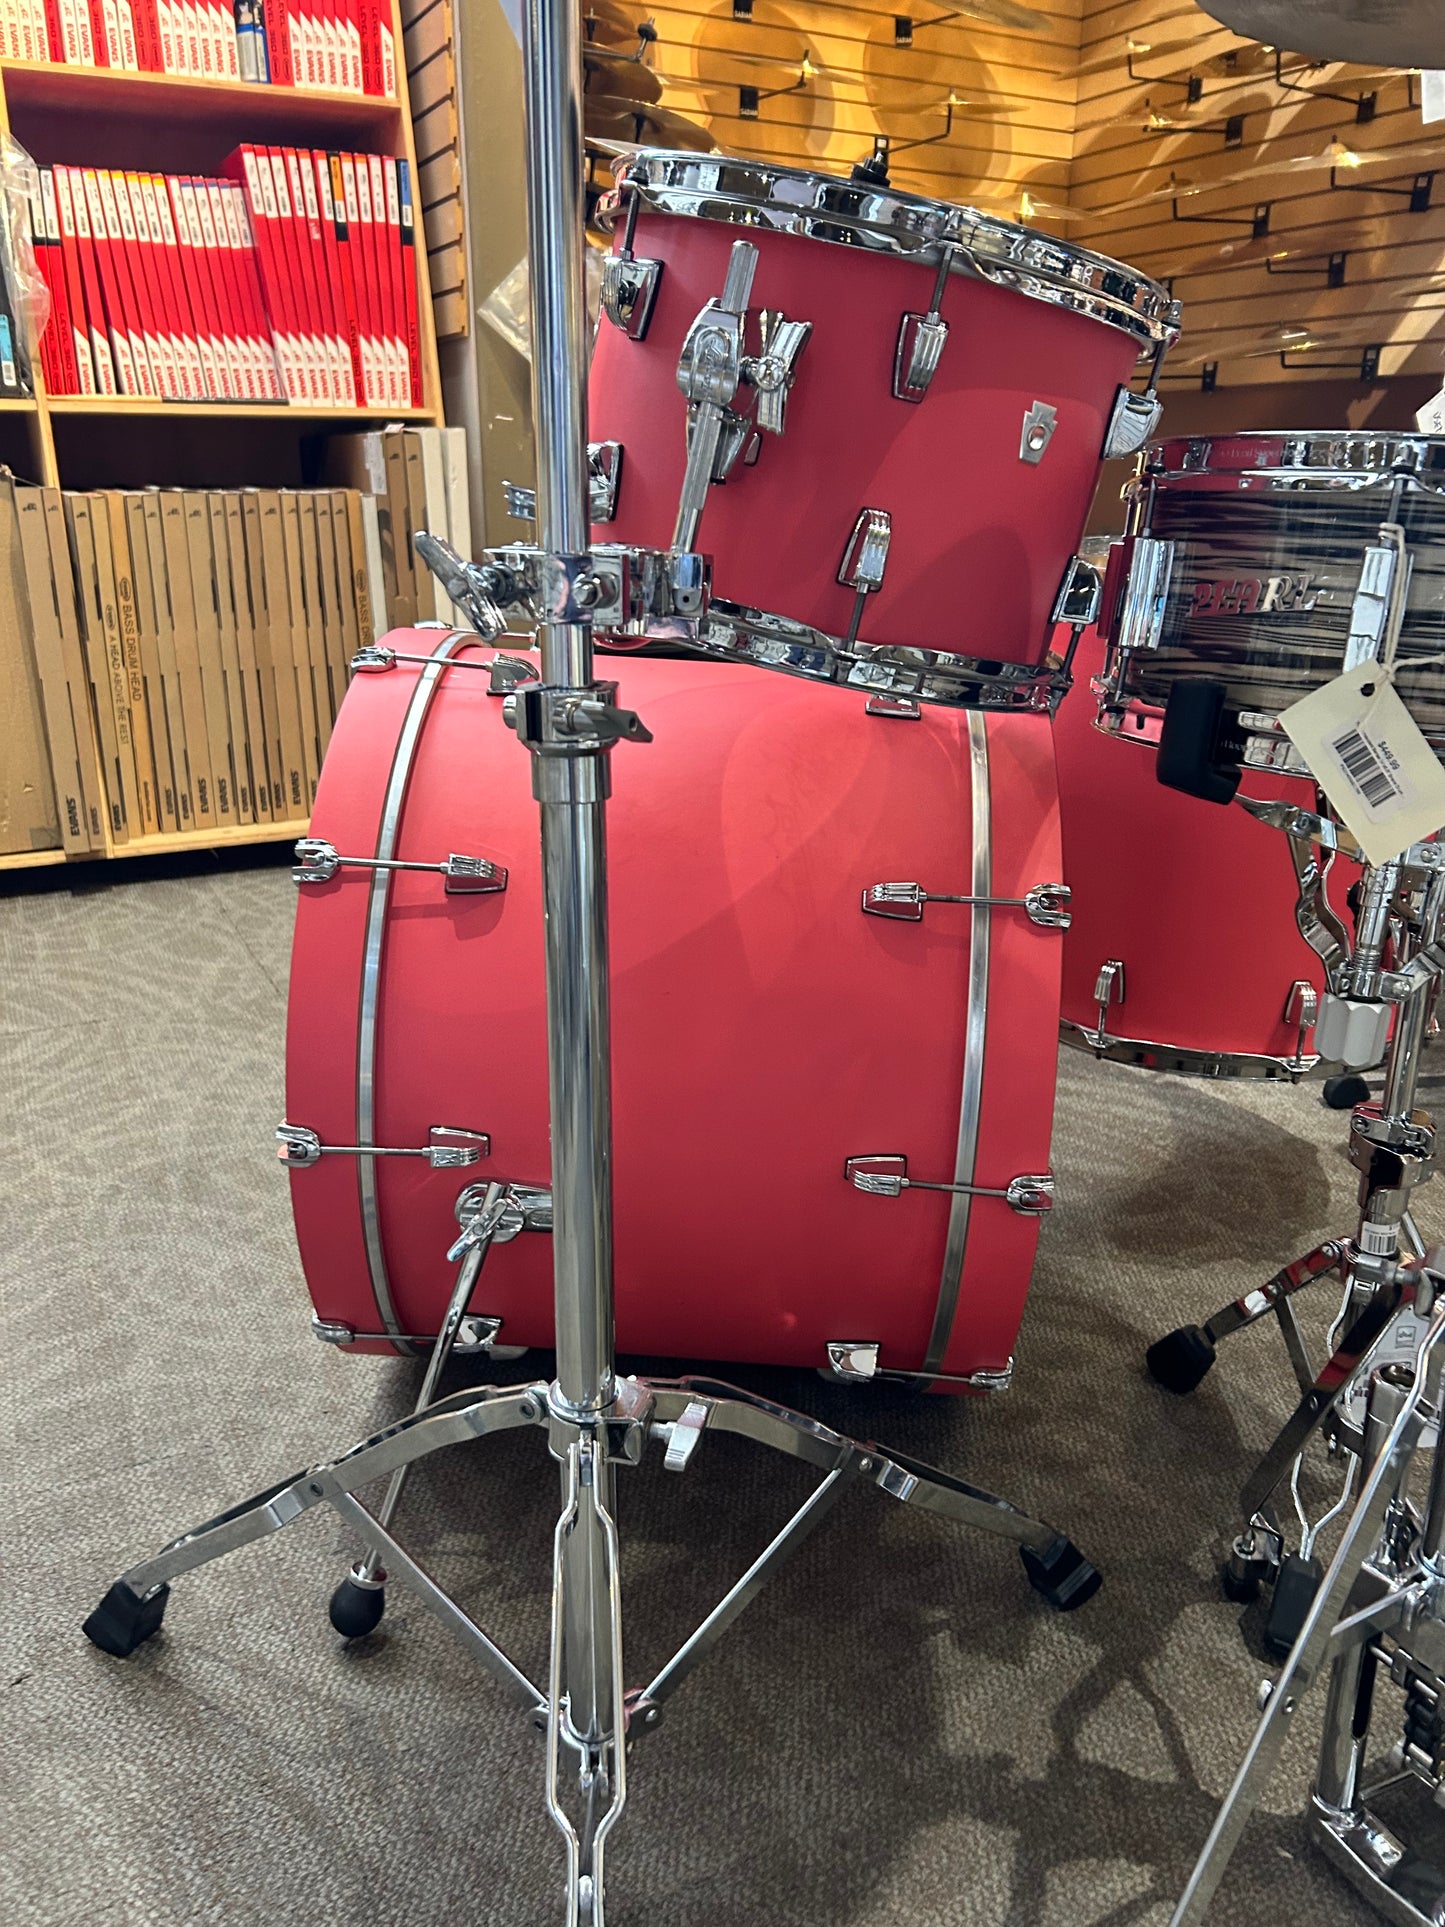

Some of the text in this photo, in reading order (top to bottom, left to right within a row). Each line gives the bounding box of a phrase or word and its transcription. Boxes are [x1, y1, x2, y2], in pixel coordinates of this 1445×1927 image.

[9, 23, 20, 58] EVANS
[23, 25, 33, 60] EVANS
[36, 27, 47, 61] EVANS
[66, 23, 77, 58] EVANS
[80, 23, 91, 59] EVANS
[109, 28, 119, 62] EVANS
[124, 29, 134, 64] EVANS
[163, 33, 173, 68] EVANS
[176, 34, 186, 69] EVANS
[189, 36, 199, 71] EVANS
[202, 38, 212, 72] EVANS
[215, 39, 224, 73] EVANS
[227, 41, 237, 75] EVANS
[294, 49, 302, 82] EVANS
[307, 50, 315, 83] EVANS
[317, 51, 326, 84] EVANS
[328, 52, 337, 85] EVANS
[341, 54, 349, 86] EVANS
[352, 55, 360, 88] EVANS
[385, 58, 394, 91] EVANS
[81, 363, 93, 395] EVANS
[101, 364, 113, 395] EVANS
[123, 364, 136, 395] EVANS
[139, 364, 152, 396] EVANS
[153, 365, 167, 397] EVANS
[167, 366, 178, 398] EVANS
[180, 366, 192, 398] EVANS
[192, 367, 204, 398] EVANS
[206, 367, 217, 398] EVANS
[220, 368, 231, 399] EVANS
[233, 368, 245, 399] EVANS
[245, 369, 256, 399] EVANS
[256, 369, 267, 399] EVANS
[268, 369, 279, 399] EVANS
[286, 368, 297, 398] EVANS
[297, 368, 308, 399] EVANS
[309, 369, 320, 399] EVANS
[320, 369, 329, 399] EVANS
[332, 370, 342, 400] EVANS
[344, 370, 353, 400] EVANS
[366, 370, 375, 400] EVANS
[377, 370, 385, 400] EVANS
[389, 371, 398, 400] EVANS
[401, 371, 409, 400] EVANS
[359, 595, 368, 624] BASS
[1187, 575, 1317, 617] PEARL
[123, 605, 135, 635] BASS
[361, 626, 370, 646] DRU
[110, 644, 120, 670] HEAD
[126, 637, 138, 669] DRUM
[114, 672, 124, 704] ABOVE
[131, 672, 142, 701] HEAD
[1378, 741, 1400, 770] $449.99
[198, 778, 209, 813] EVANS
[218, 778, 229, 813] EVANS
[291, 770, 301, 805] EVANS
[67, 797, 80, 836] EVANS
